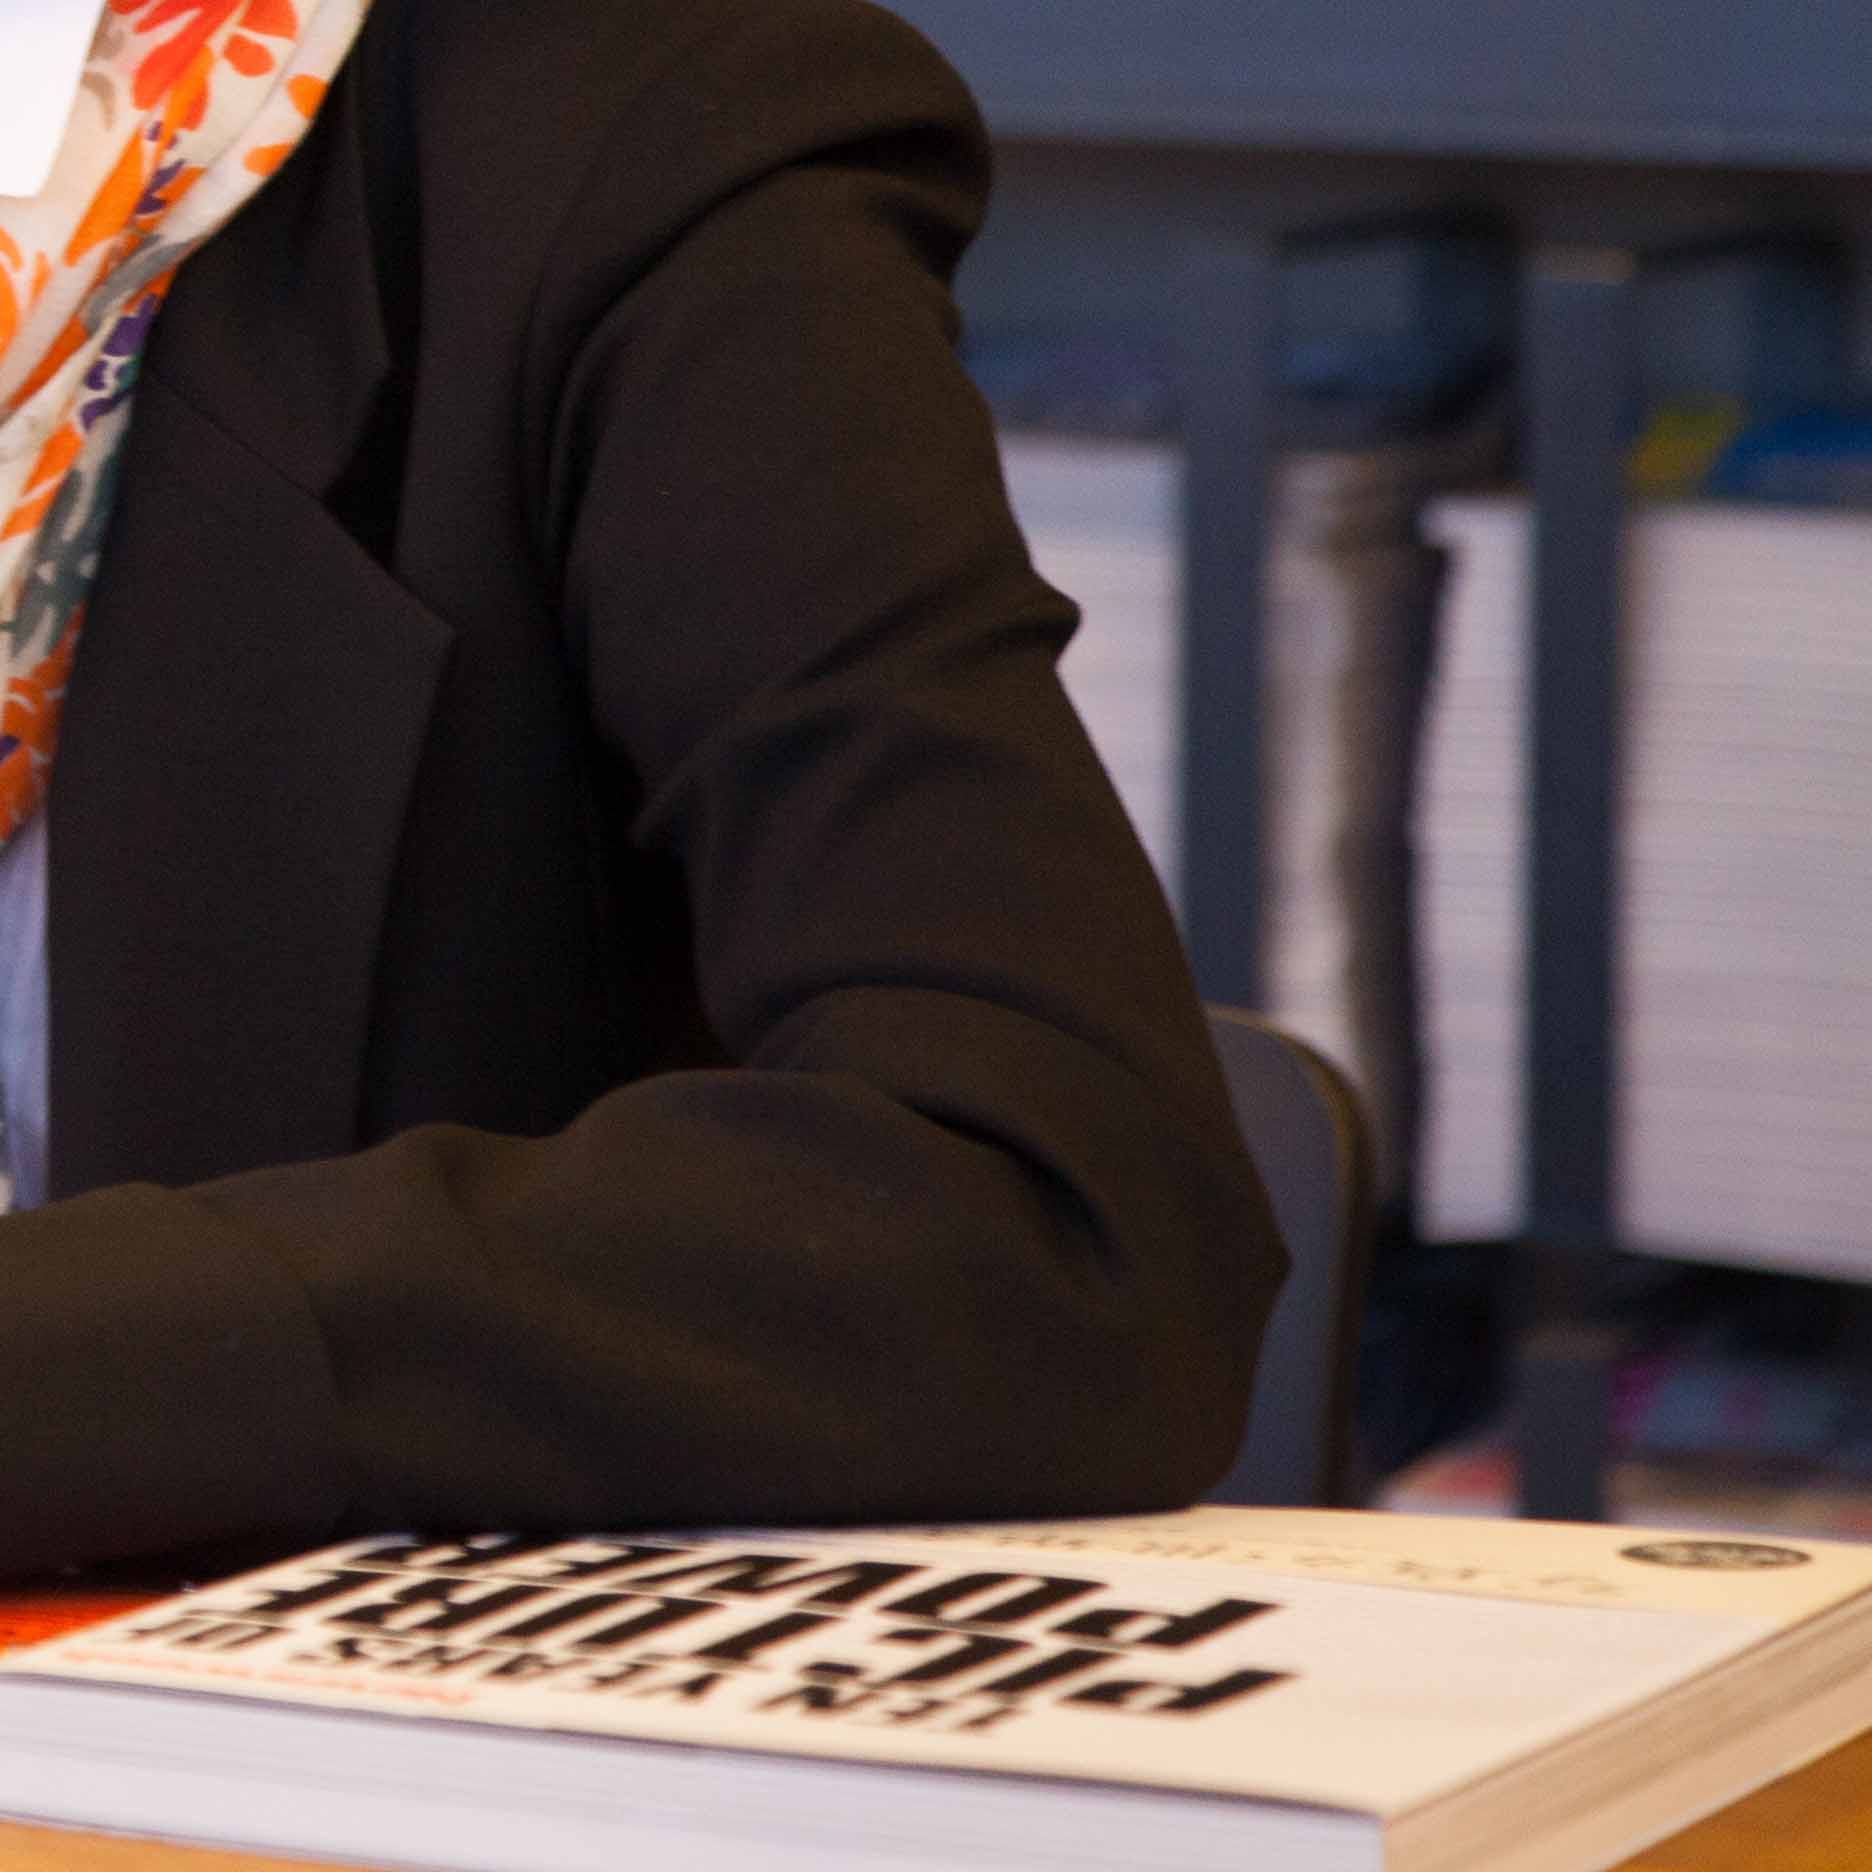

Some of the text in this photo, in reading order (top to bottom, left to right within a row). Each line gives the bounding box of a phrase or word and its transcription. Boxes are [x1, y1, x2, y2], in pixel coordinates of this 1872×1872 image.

[344, 1532, 1285, 1648] POWER
[236, 1569, 1299, 1717] PICTURE
[296, 1638, 734, 1705] YEARS
[754, 1681, 1035, 1734] TEN
